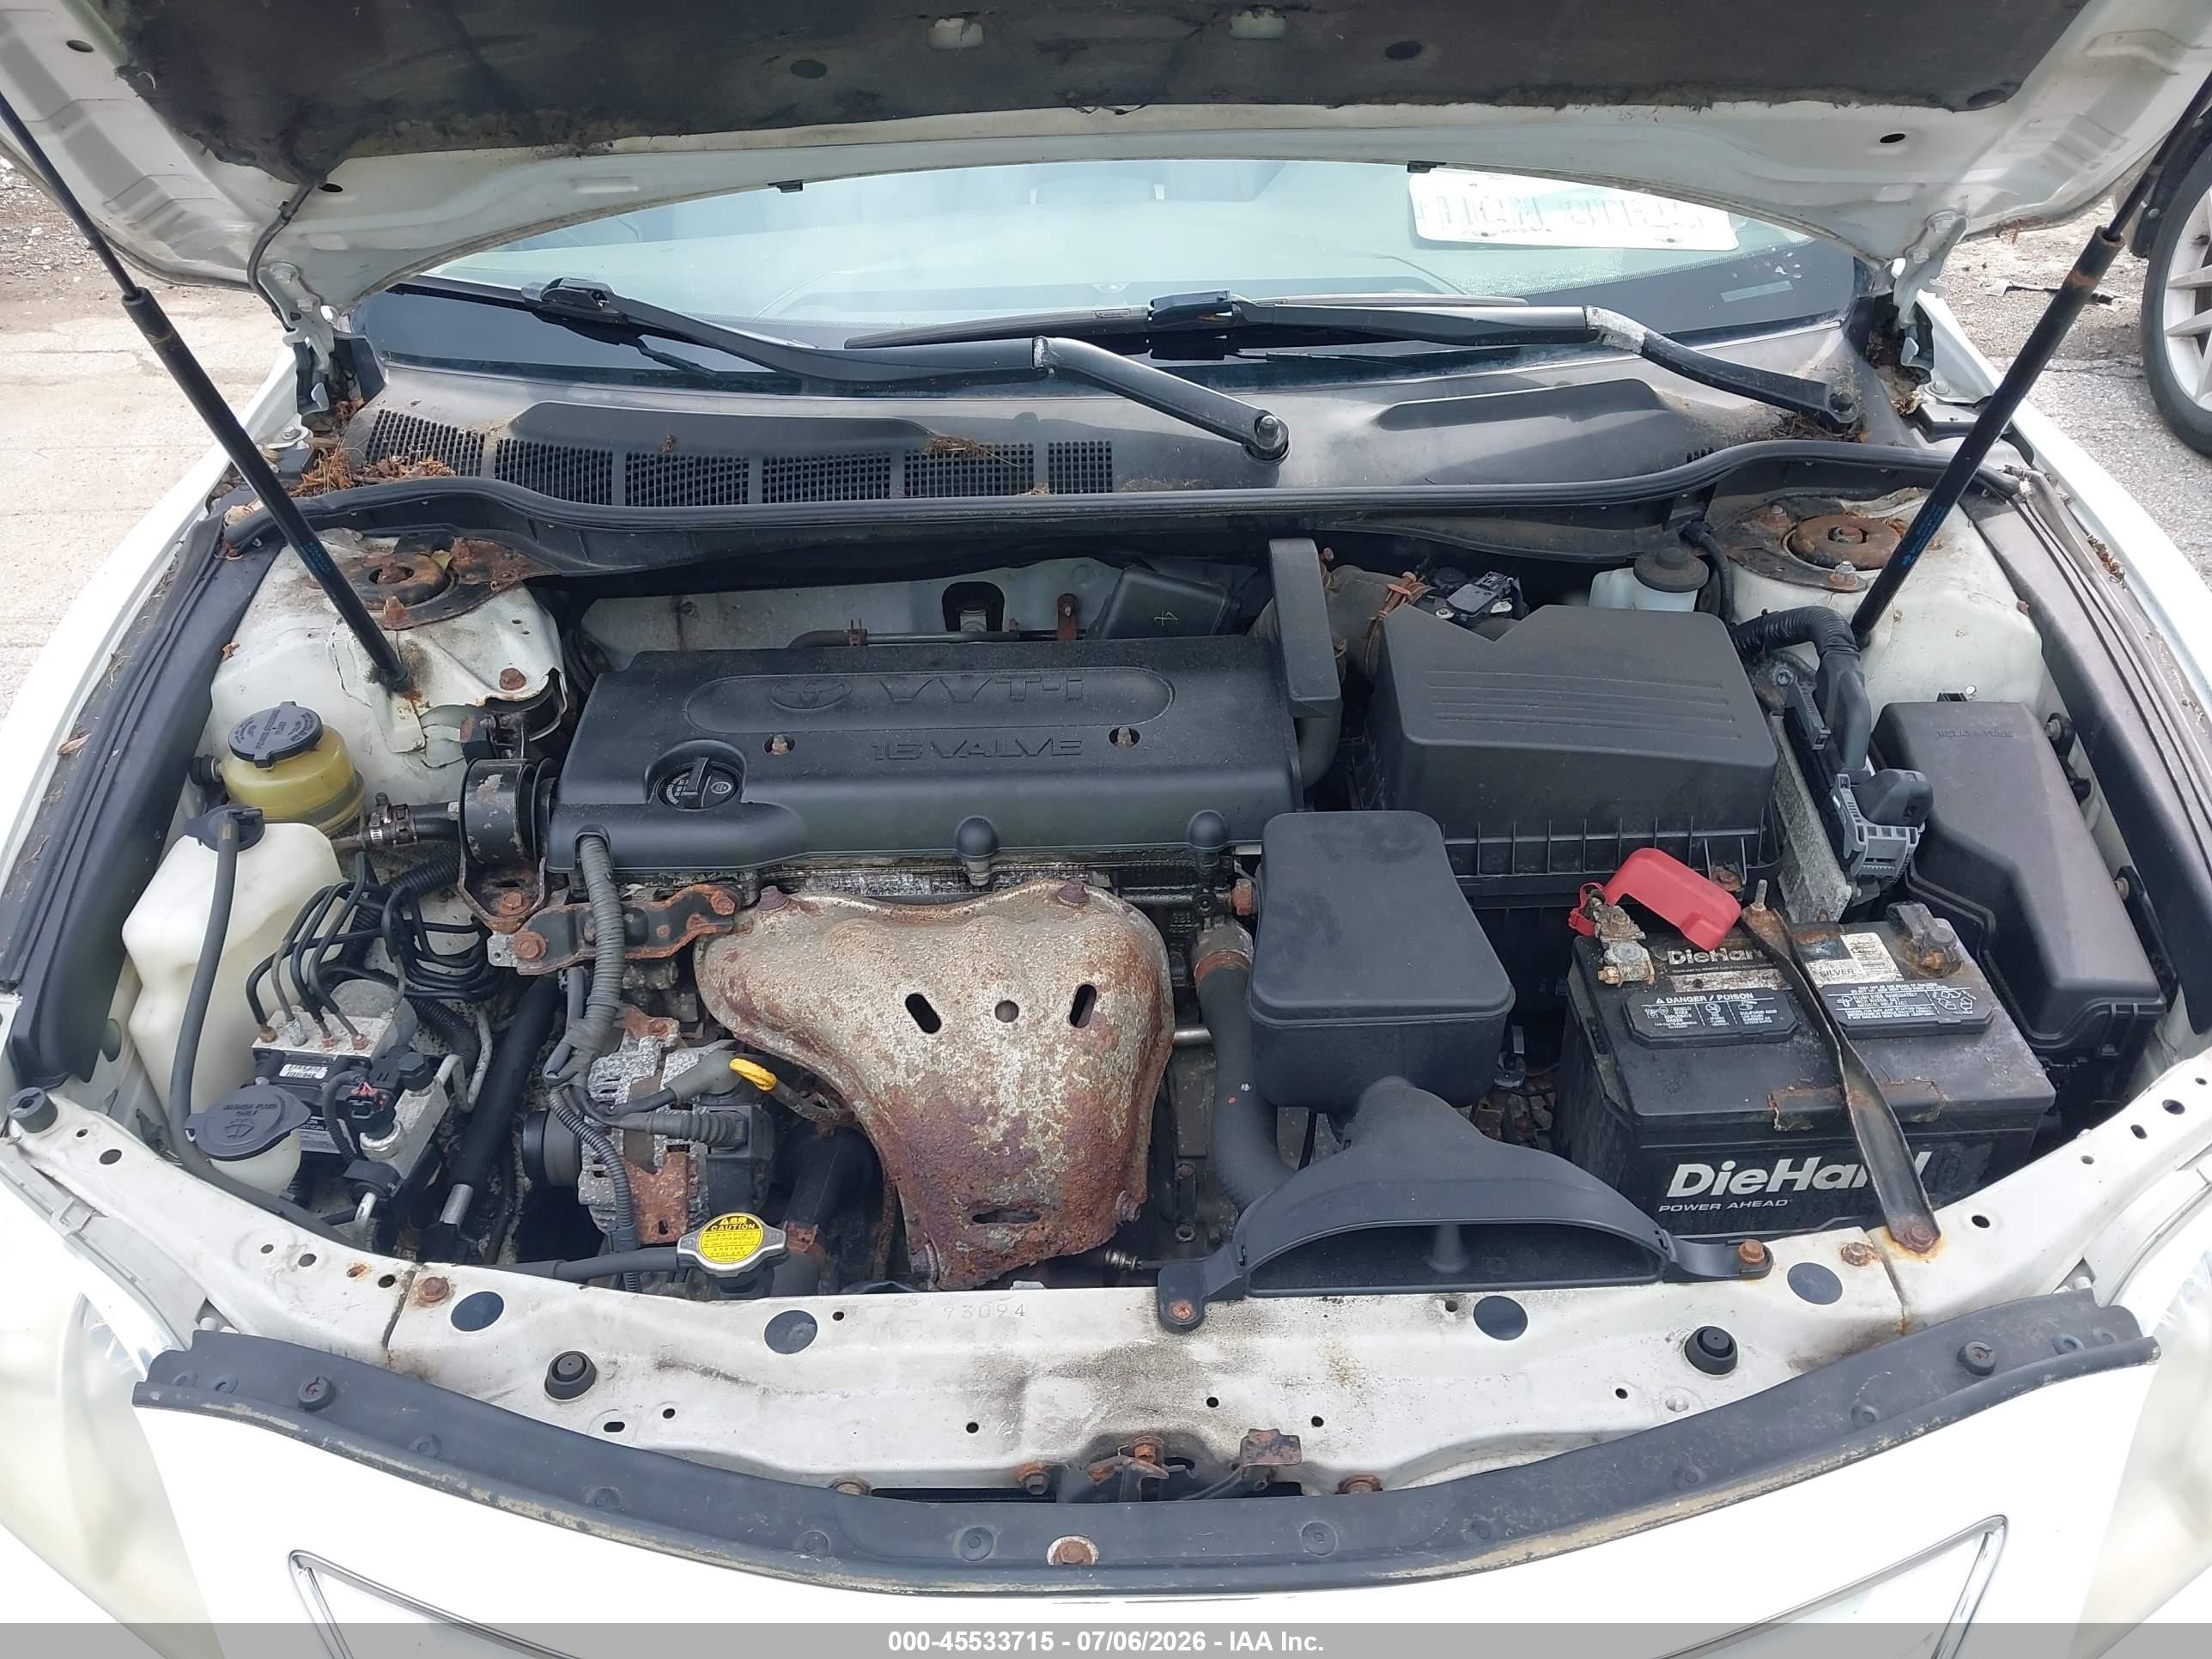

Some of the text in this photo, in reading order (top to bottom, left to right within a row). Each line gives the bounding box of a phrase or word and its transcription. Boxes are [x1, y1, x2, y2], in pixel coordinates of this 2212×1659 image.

[930, 736, 1083, 760] VALVE
[1820, 968, 1856, 977] SILVER
[1665, 995, 1708, 1004] DANGER
[1717, 992, 1754, 1001] POISON
[1657, 1199, 1790, 1213] POWER AHEAD
[710, 1223, 755, 1231] CAUTION
[944, 1304, 1026, 1320] 73094
